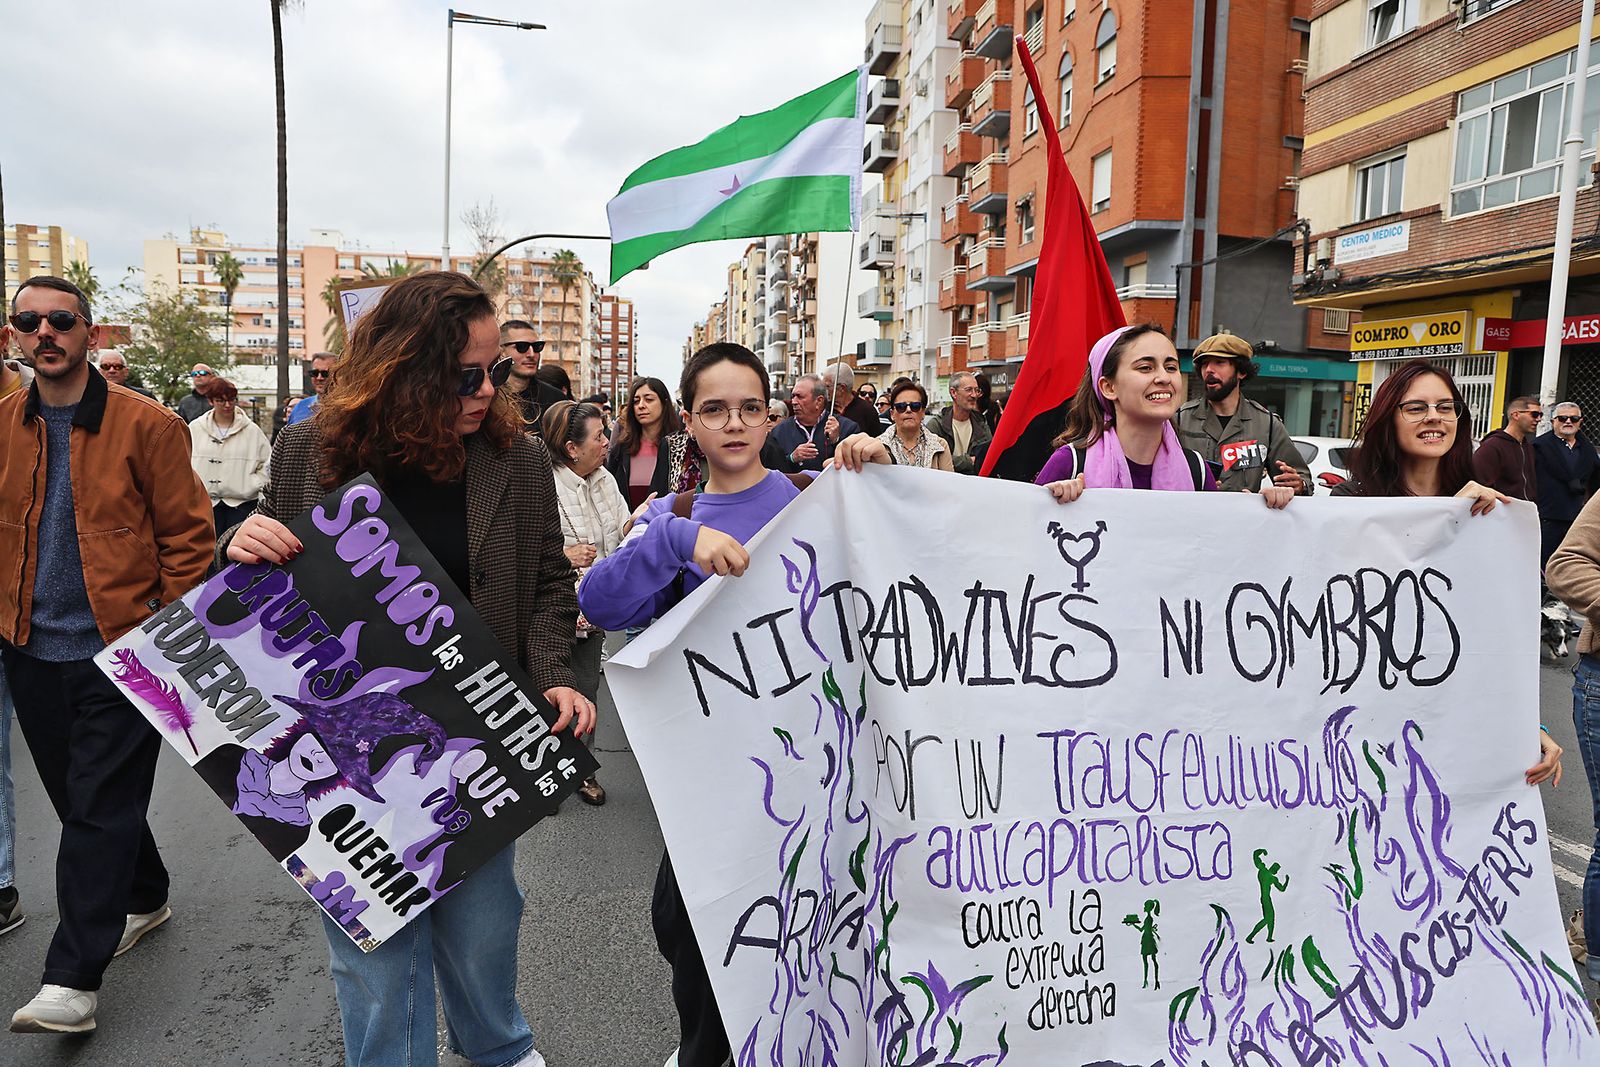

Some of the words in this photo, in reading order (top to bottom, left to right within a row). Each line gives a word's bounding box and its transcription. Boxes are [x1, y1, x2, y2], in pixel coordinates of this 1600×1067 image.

[1341, 233, 1369, 248] CENTRO
[1354, 326, 1409, 343] COMPRO
[1429, 321, 1461, 337] ORO
[1365, 350, 1376, 359] 959
[1376, 348, 1387, 358] 813
[1388, 348, 1399, 357] 007
[1422, 346, 1434, 355] 645
[1436, 344, 1448, 354] 304
[1449, 343, 1462, 353] 342
[1486, 327, 1510, 337] GAES
[1223, 443, 1257, 461] CNT
[1239, 459, 1250, 467] AIT
[223, 562, 363, 699] BRUJAS
[311, 483, 455, 646] SOMOS
[432, 634, 464, 671] las
[454, 660, 561, 771] HIJAS
[683, 607, 812, 717] NI
[818, 574, 1119, 692] TRADWIVES
[1159, 597, 1204, 678] NI
[1225, 567, 1461, 695] GYMBROS
[141, 600, 281, 743] PUDIERON
[450, 749, 520, 818] QUE
[534, 770, 559, 797] las
[318, 804, 431, 917] QUEMAR
[311, 870, 370, 926] 8M
[1005, 934, 1104, 990] extrema
[1027, 979, 1116, 1031] derecha
